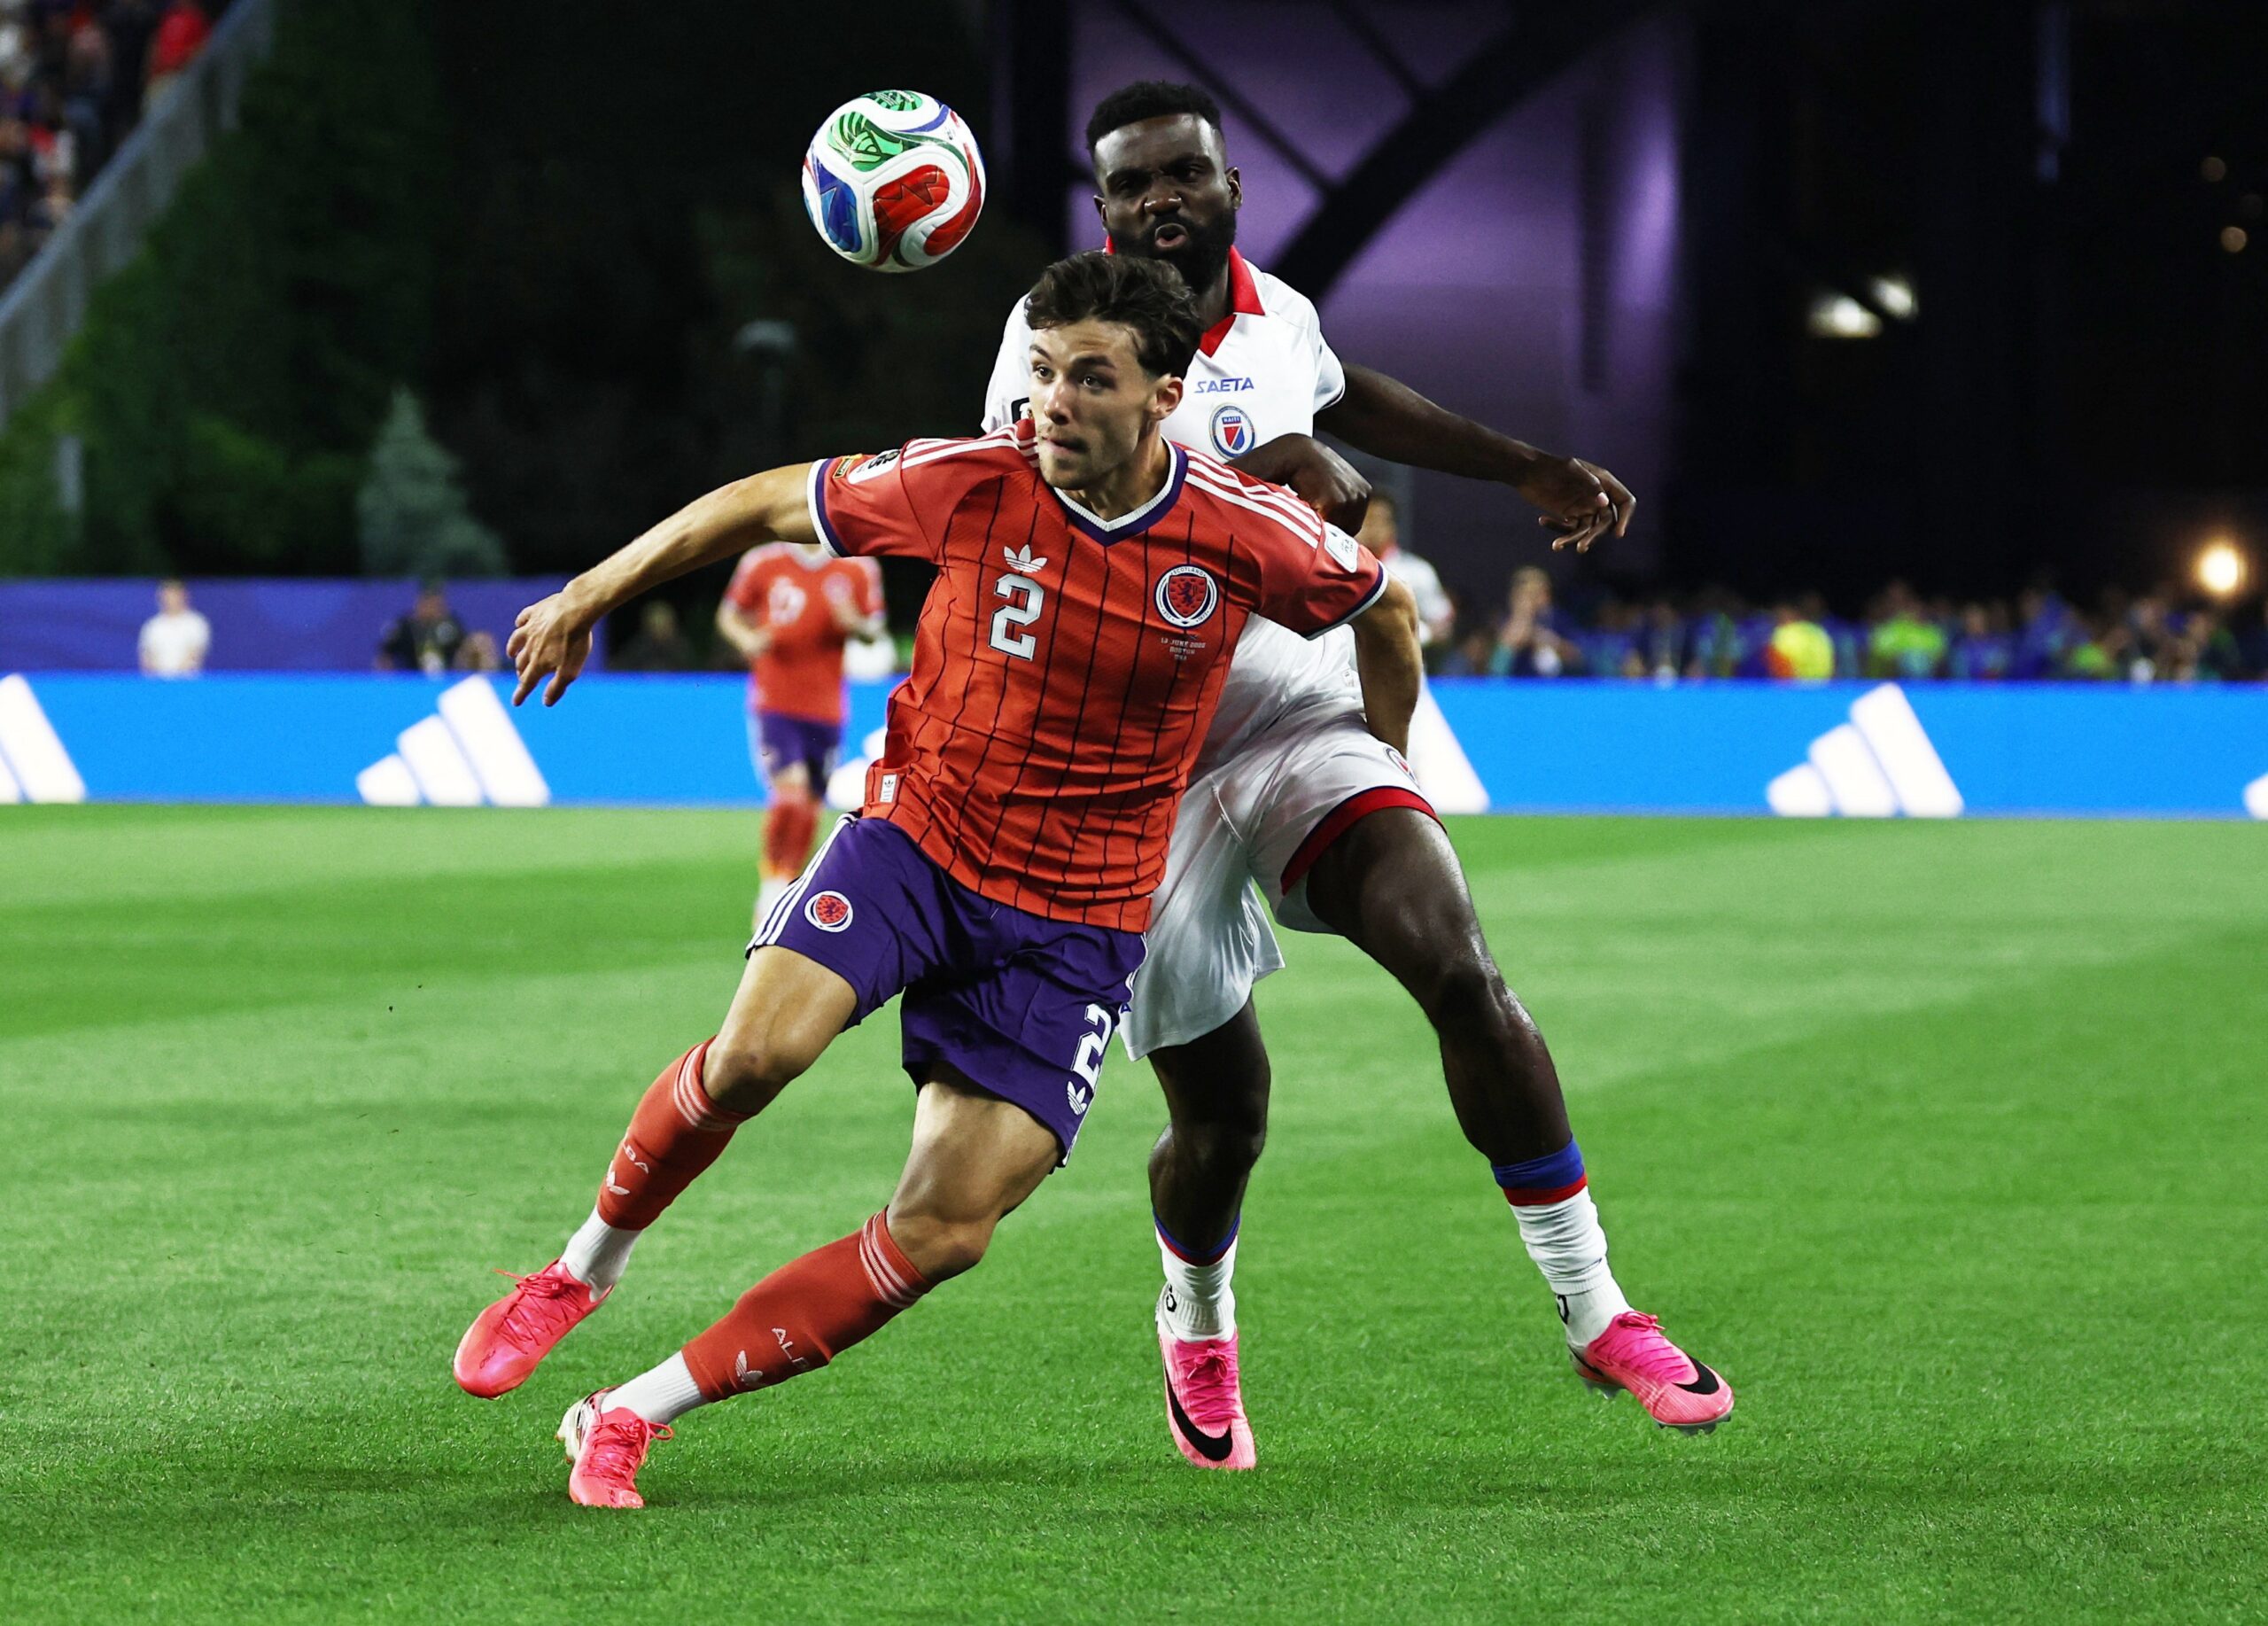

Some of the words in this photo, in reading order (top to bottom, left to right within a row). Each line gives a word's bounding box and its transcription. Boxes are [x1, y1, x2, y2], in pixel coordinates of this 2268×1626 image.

[1194, 377, 1254, 393] SAETA
[1173, 567, 1204, 576] SCOTLAND
[988, 572, 1045, 661] 2
[1070, 1003, 1111, 1093] 2
